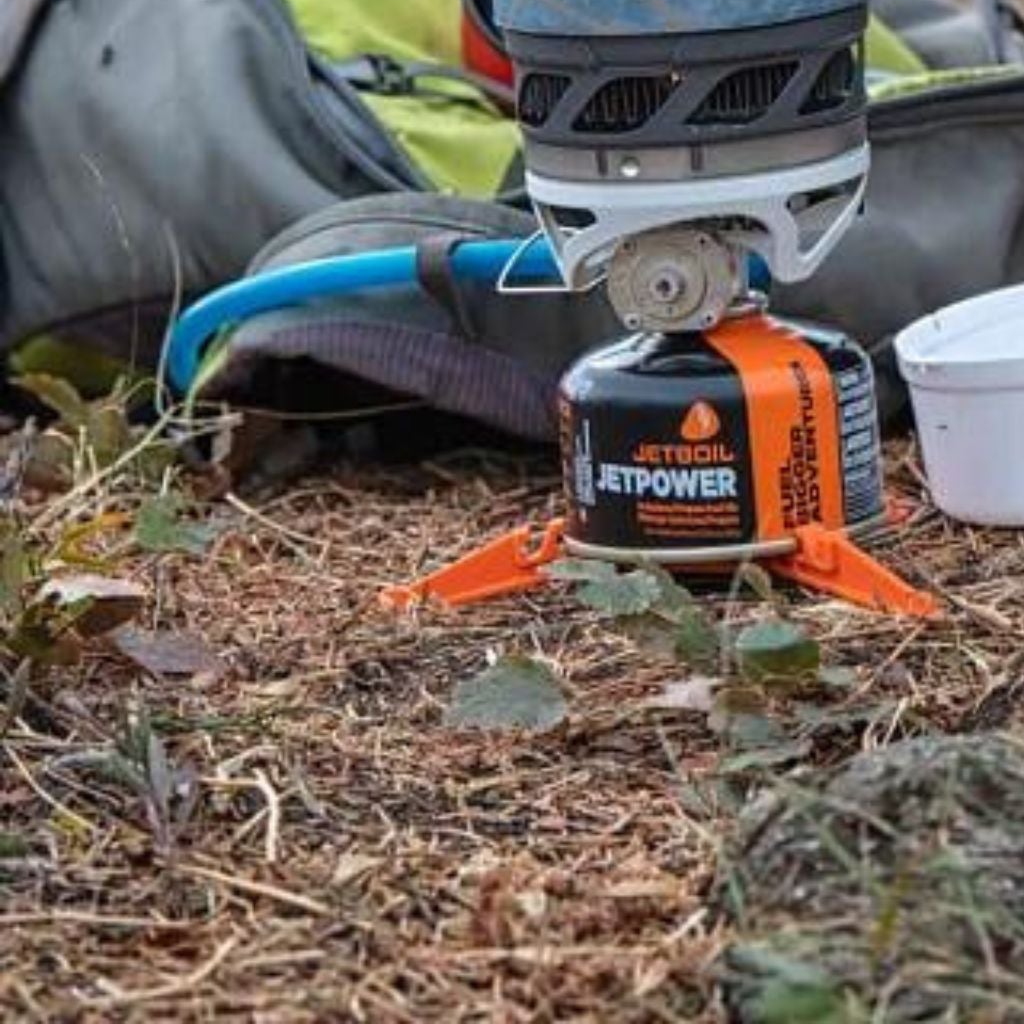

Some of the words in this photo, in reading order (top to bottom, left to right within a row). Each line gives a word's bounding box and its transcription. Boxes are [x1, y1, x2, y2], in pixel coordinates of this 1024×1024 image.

[632, 442, 735, 465] JETBOIL
[597, 462, 738, 498] JETPOWER
[779, 456, 797, 529] FUEL
